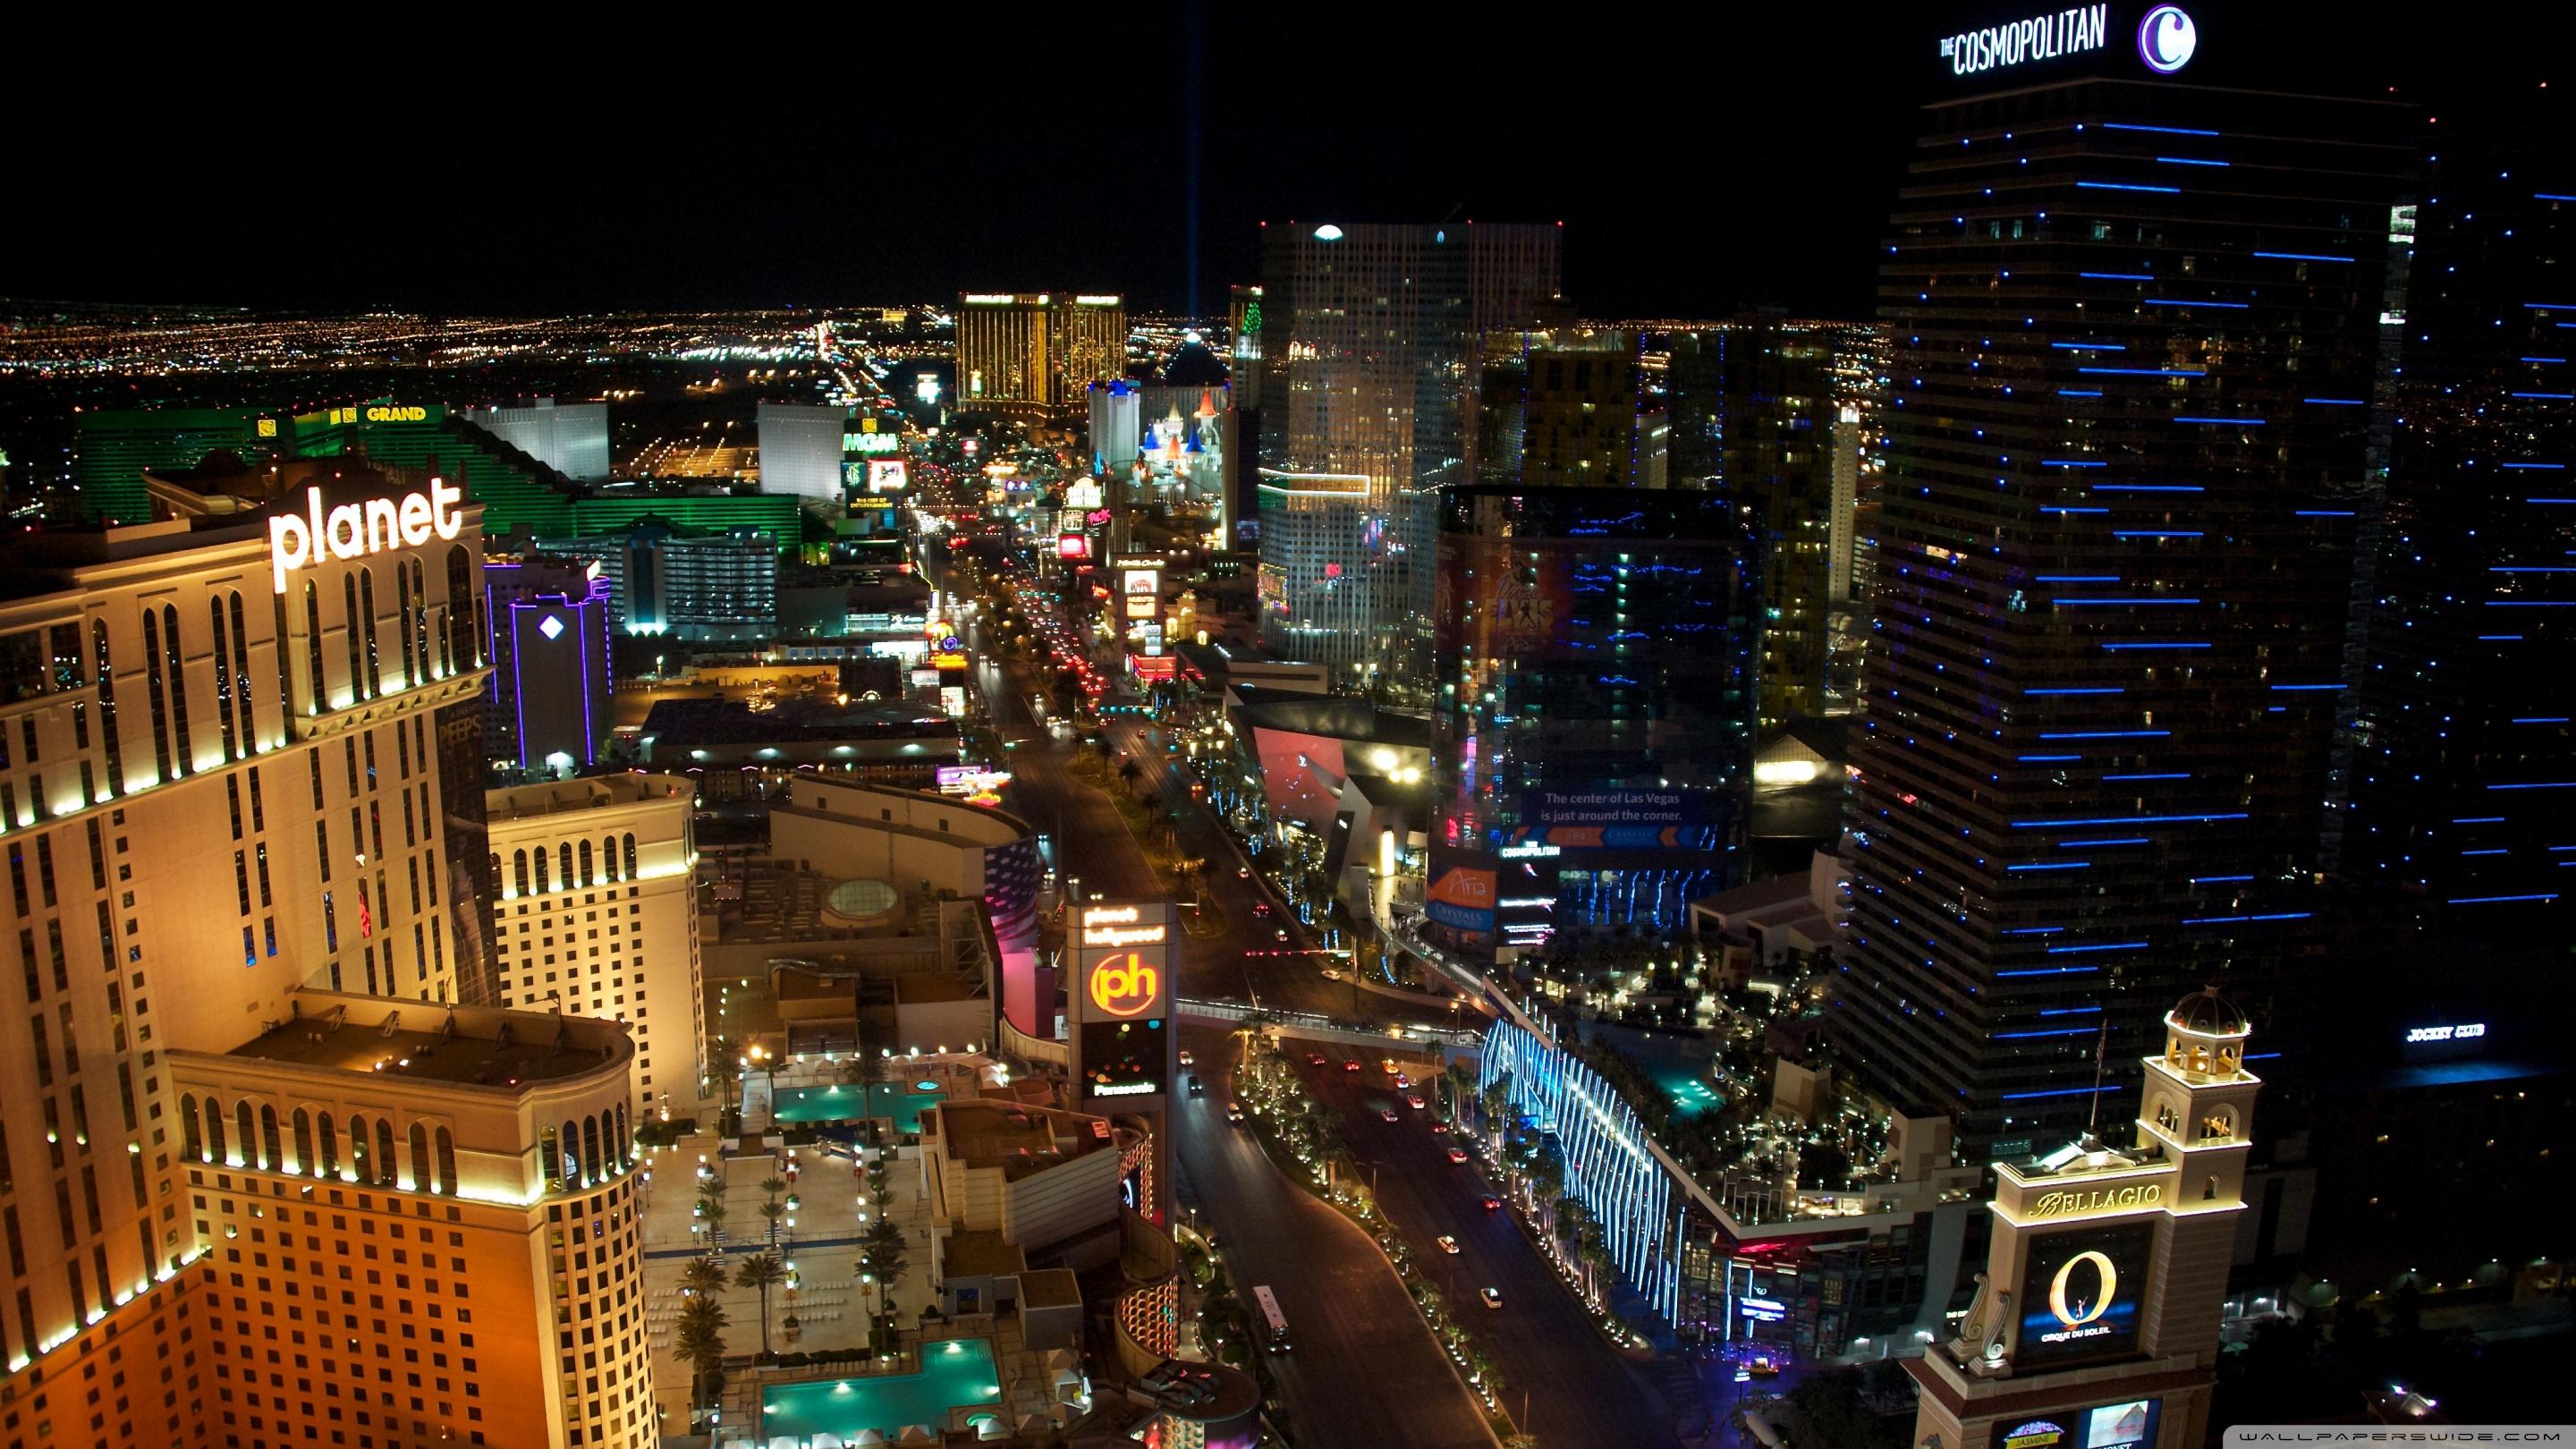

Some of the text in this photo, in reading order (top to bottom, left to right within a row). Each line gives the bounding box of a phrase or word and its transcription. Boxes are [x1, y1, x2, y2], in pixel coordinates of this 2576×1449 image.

[1940, 3, 2106, 75] THE COSMOPOLITAN
[367, 407, 427, 422] GRAND
[842, 433, 898, 453] MGM
[268, 477, 462, 595] planet
[1546, 792, 1681, 806] The center of Las Vegas
[1541, 809, 1682, 823] is just around the corner.
[1502, 846, 1560, 858] COSMOPOLITAN
[1449, 870, 1487, 896] Aria
[1084, 907, 1138, 928] planet
[1435, 902, 1482, 920] CRYSTALS
[1084, 926, 1165, 947] hollywood
[1098, 953, 1157, 1009] ph
[2406, 1023, 2485, 1042] JOCKEY CLUB
[1094, 1082, 1156, 1097] Panasonic
[2029, 1184, 2161, 1217] BELLAGIO
[2049, 1250, 2117, 1325] O
[2041, 1326, 2112, 1343] CIRQUE DU SOLEIL
[2015, 1435, 2049, 1447] JASMINE
